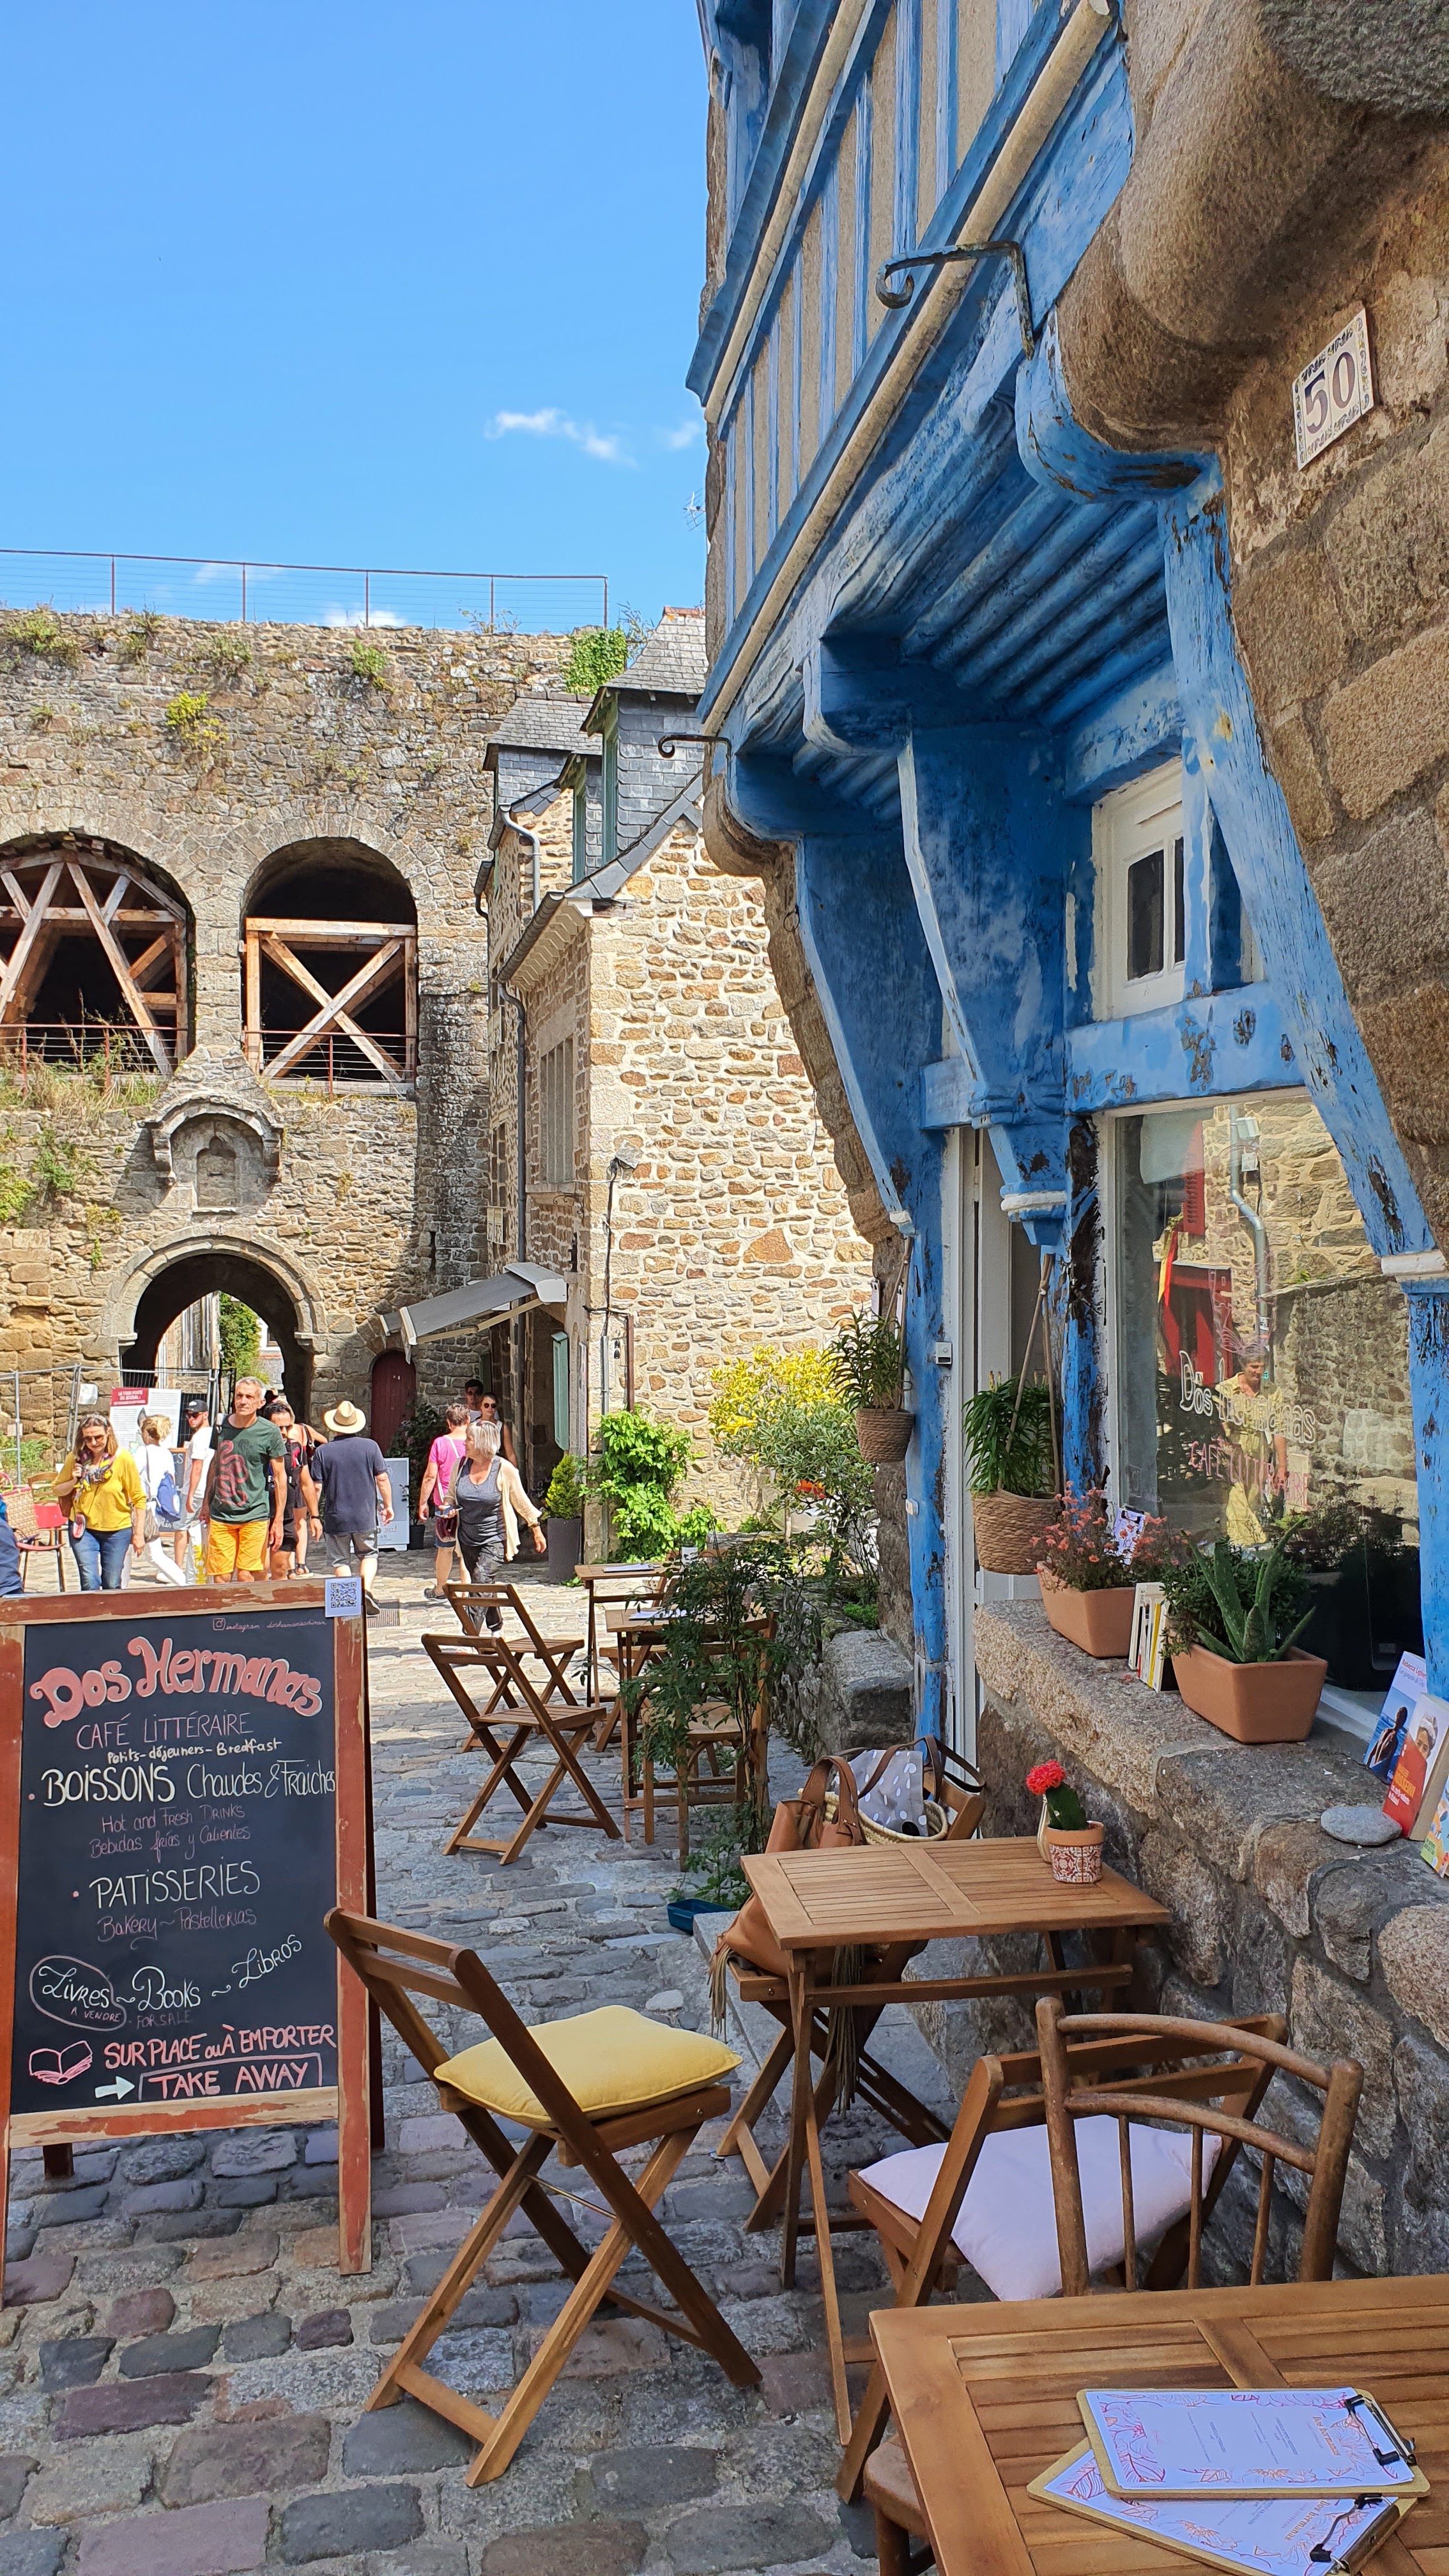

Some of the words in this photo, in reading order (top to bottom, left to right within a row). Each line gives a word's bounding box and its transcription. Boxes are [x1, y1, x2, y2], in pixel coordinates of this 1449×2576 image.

[1304, 351, 1356, 434] 50
[1179, 1350, 1213, 1416] Dos
[226, 1623, 260, 1632] instagram
[29, 1660, 132, 1728] Dos
[128, 1636, 323, 1717] Hermanas
[76, 1713, 131, 1749] CAFÉ
[143, 1710, 254, 1743] LITTÉRAIRE
[187, 1761, 262, 1798] Chaudes
[264, 1763, 280, 1798] &
[101, 1814, 127, 1833] Hot
[134, 1809, 157, 1831] and
[160, 1806, 193, 1826] Fresh
[199, 1804, 245, 1821] DRINKS
[89, 1835, 143, 1858] Bebidas
[150, 1830, 180, 1863] frías
[185, 1834, 195, 1860] y
[199, 1823, 250, 1844] Calientes
[89, 1856, 261, 1909] PATISSERIES
[97, 1913, 158, 1950] Bakery
[132, 1965, 201, 2011] Books
[71, 2007, 78, 2016] A
[84, 2010, 121, 2023] VENDRE
[136, 2014, 157, 2030] FOR
[160, 2009, 194, 2026] SALE
[103, 2041, 146, 2070] SUR
[147, 2033, 208, 2067] PLACE
[204, 2043, 223, 2059] ou
[239, 2024, 337, 2053] EMPORTER
[148, 2070, 220, 2099] TAKE
[235, 2062, 309, 2094] AWAY
